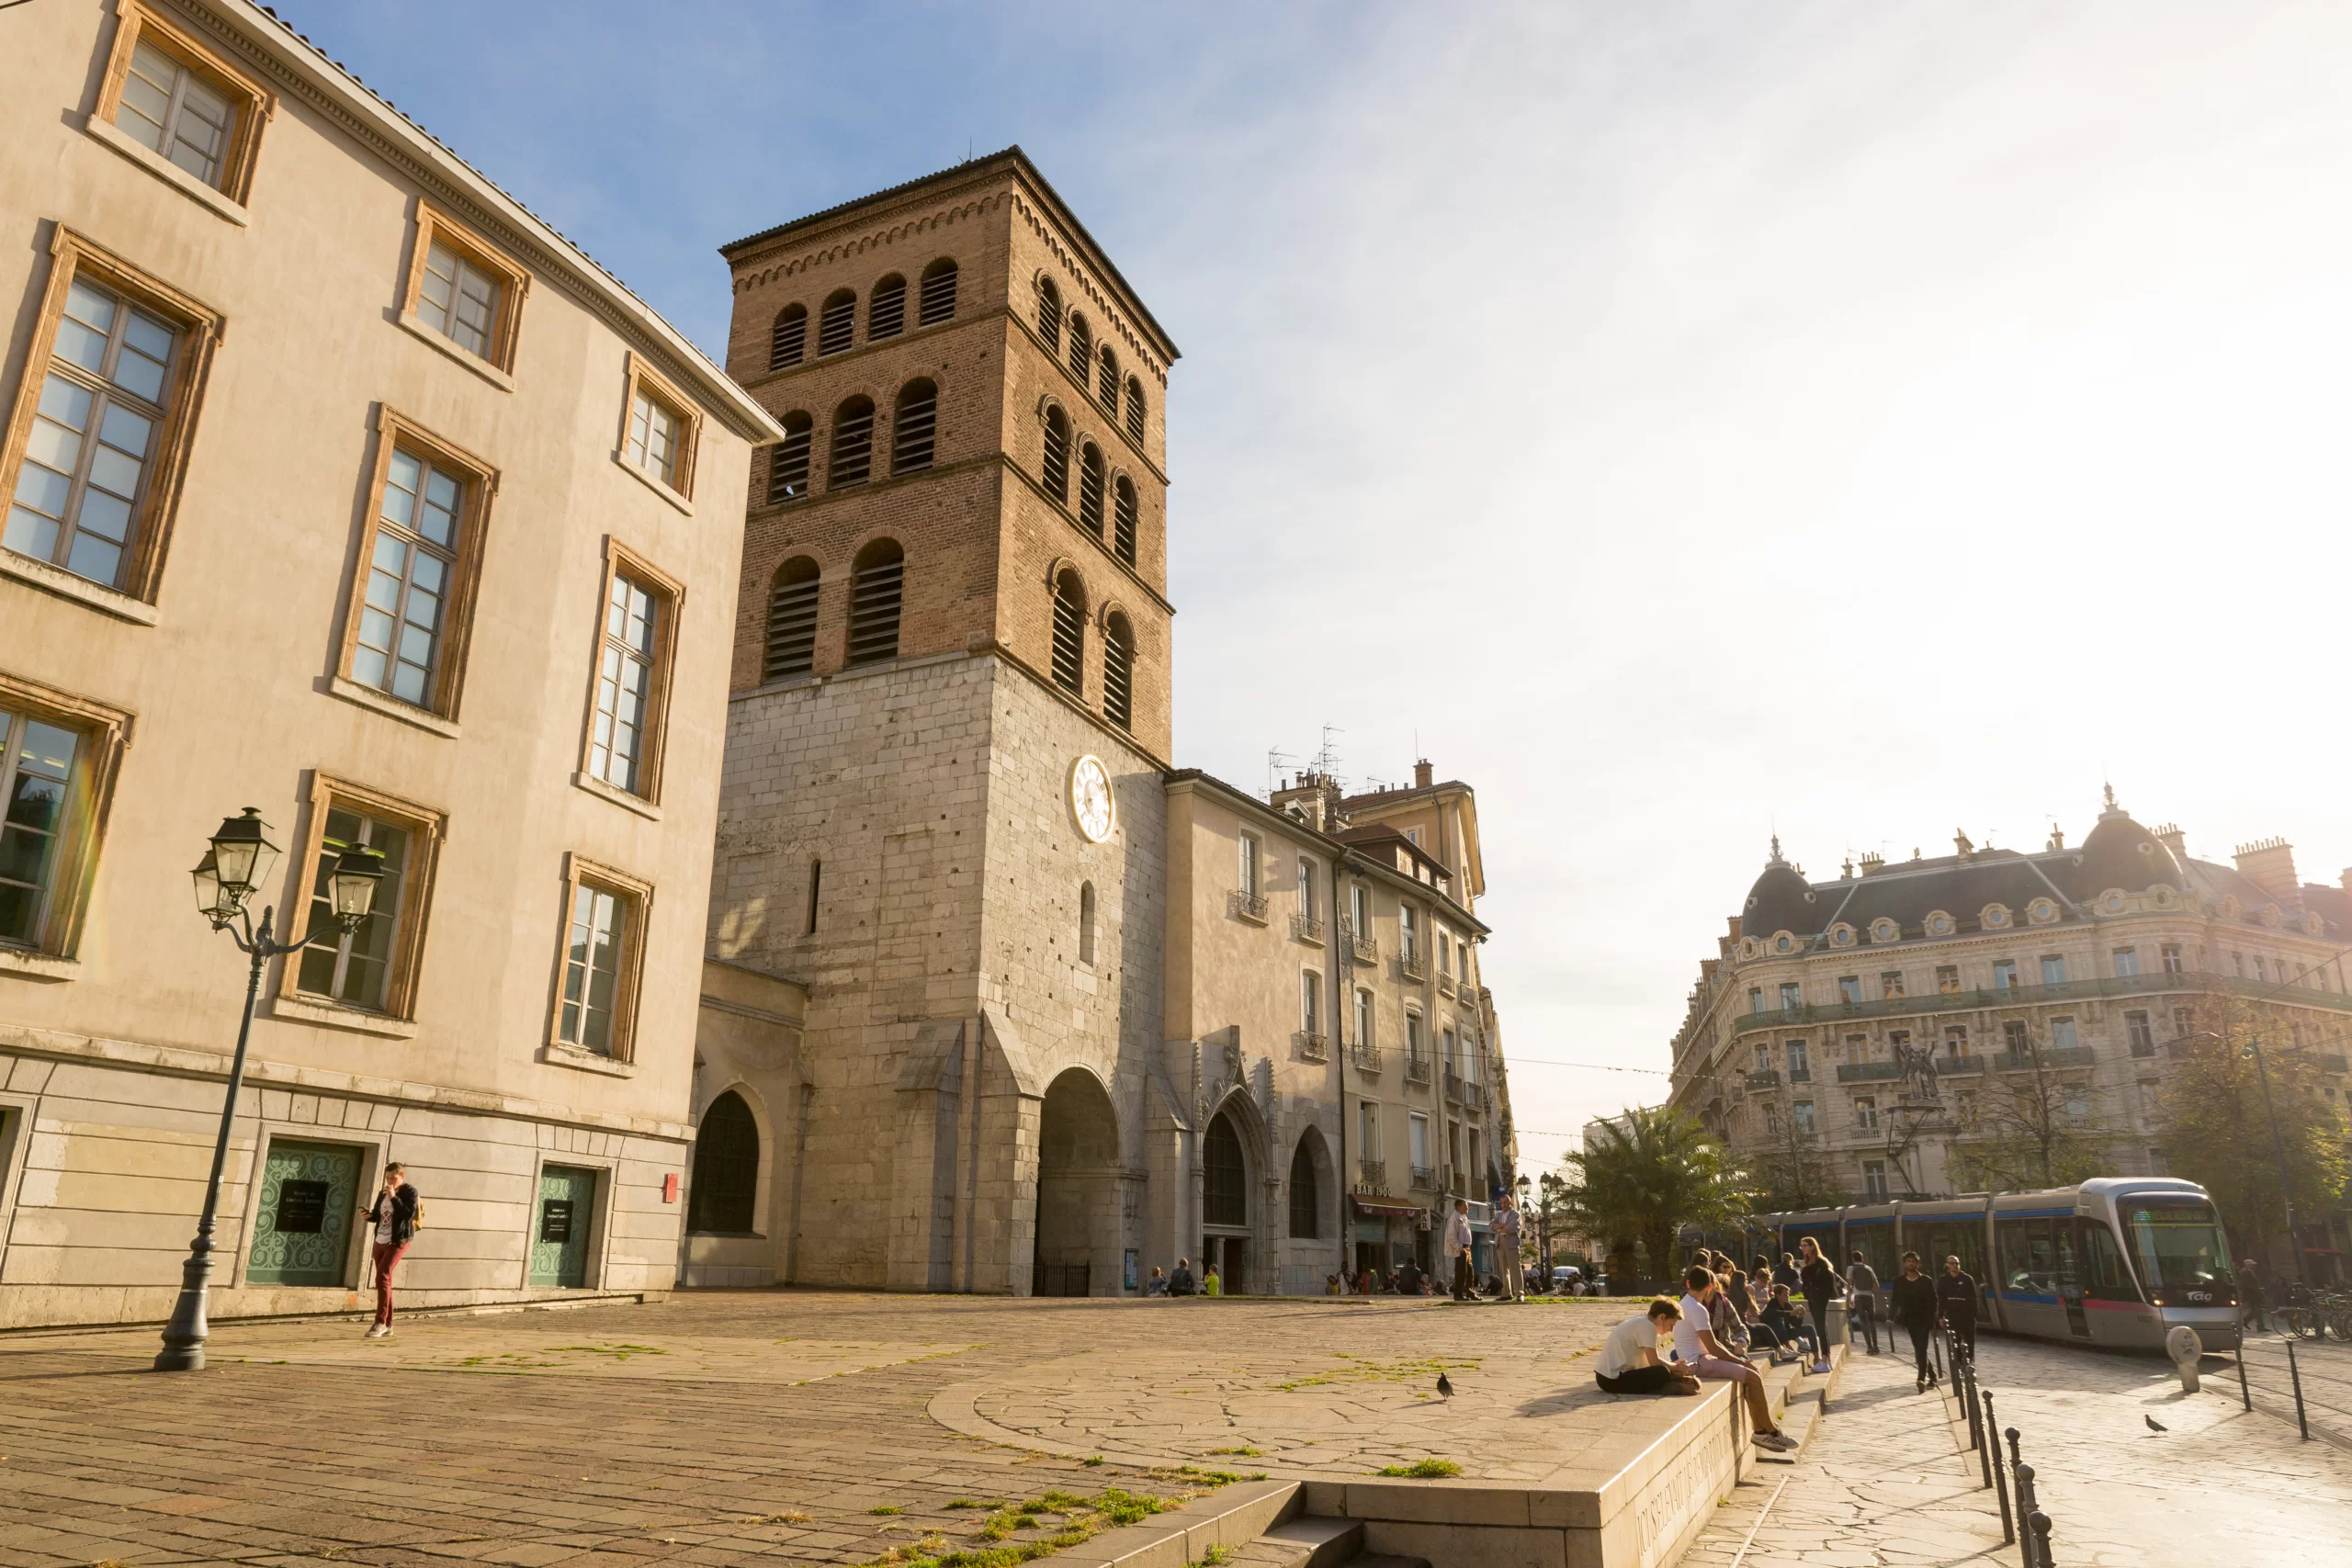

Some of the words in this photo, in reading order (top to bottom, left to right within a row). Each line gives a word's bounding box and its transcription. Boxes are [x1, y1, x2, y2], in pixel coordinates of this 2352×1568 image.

[1355, 1184, 1373, 1196] BAR
[1375, 1186, 1393, 1198] 1900
[2187, 1291, 2212, 1302] Tag
